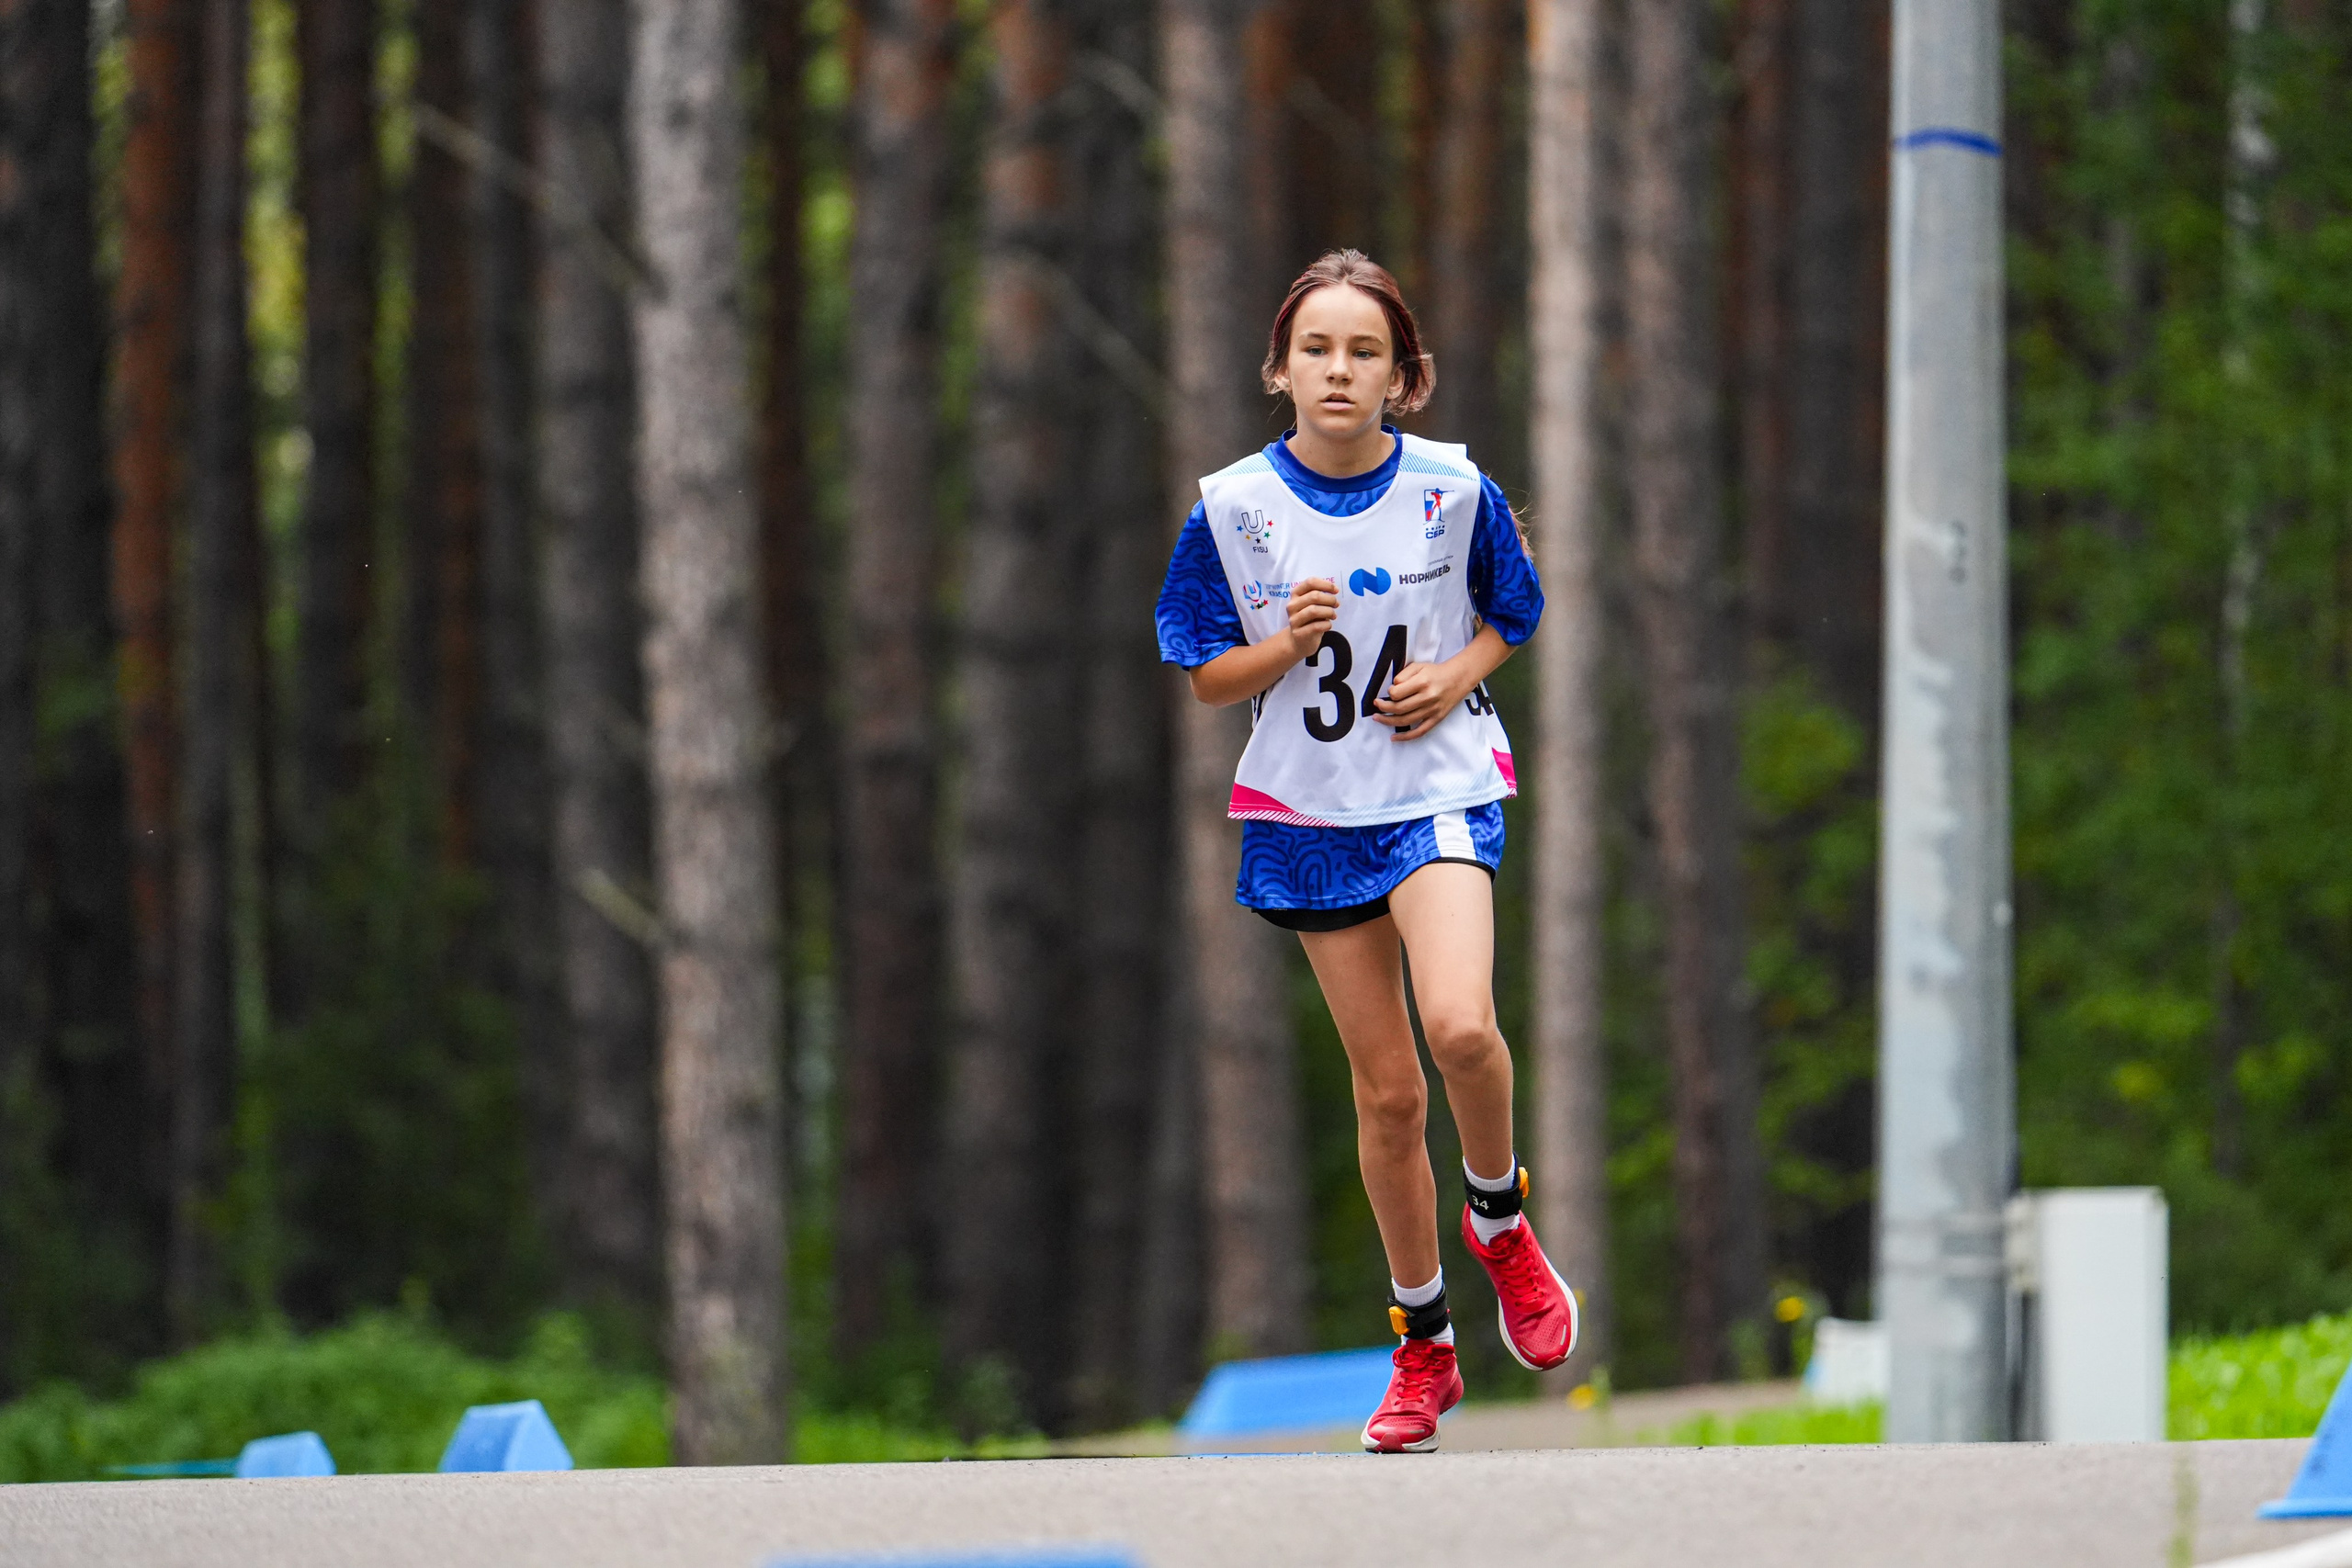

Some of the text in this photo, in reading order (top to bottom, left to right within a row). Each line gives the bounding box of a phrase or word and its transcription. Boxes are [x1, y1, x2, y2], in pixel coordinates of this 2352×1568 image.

[1399, 564, 1451, 584] НОРНИКЕЛЬ
[1303, 625, 1411, 742] 34
[1472, 1195, 1489, 1210] 34
